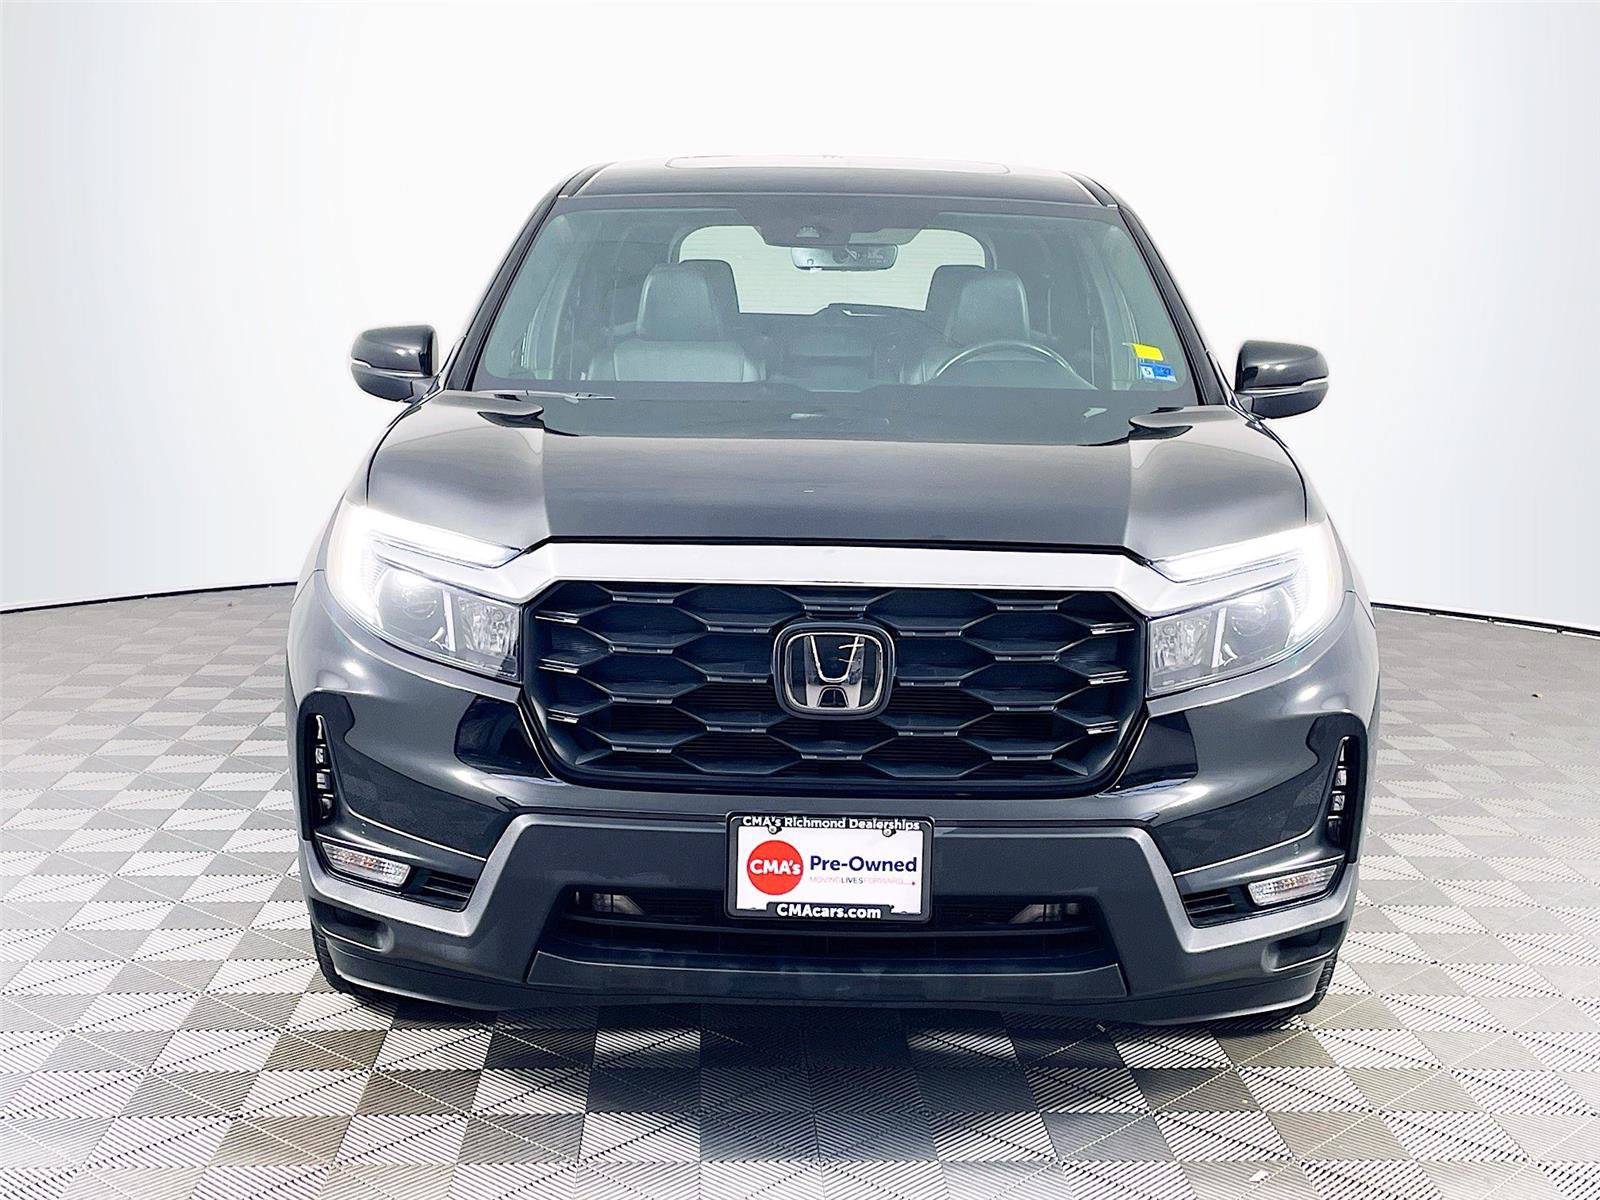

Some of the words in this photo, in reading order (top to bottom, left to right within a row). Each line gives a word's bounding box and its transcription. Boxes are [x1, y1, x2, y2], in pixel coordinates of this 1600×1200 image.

[742, 815, 782, 828] CMA's
[784, 816, 846, 829] Richmond
[849, 818, 920, 832] Dealerships
[749, 859, 802, 876] CMA's
[809, 855, 918, 872] Pre-Owned
[776, 903, 882, 919] CMAcars.com
